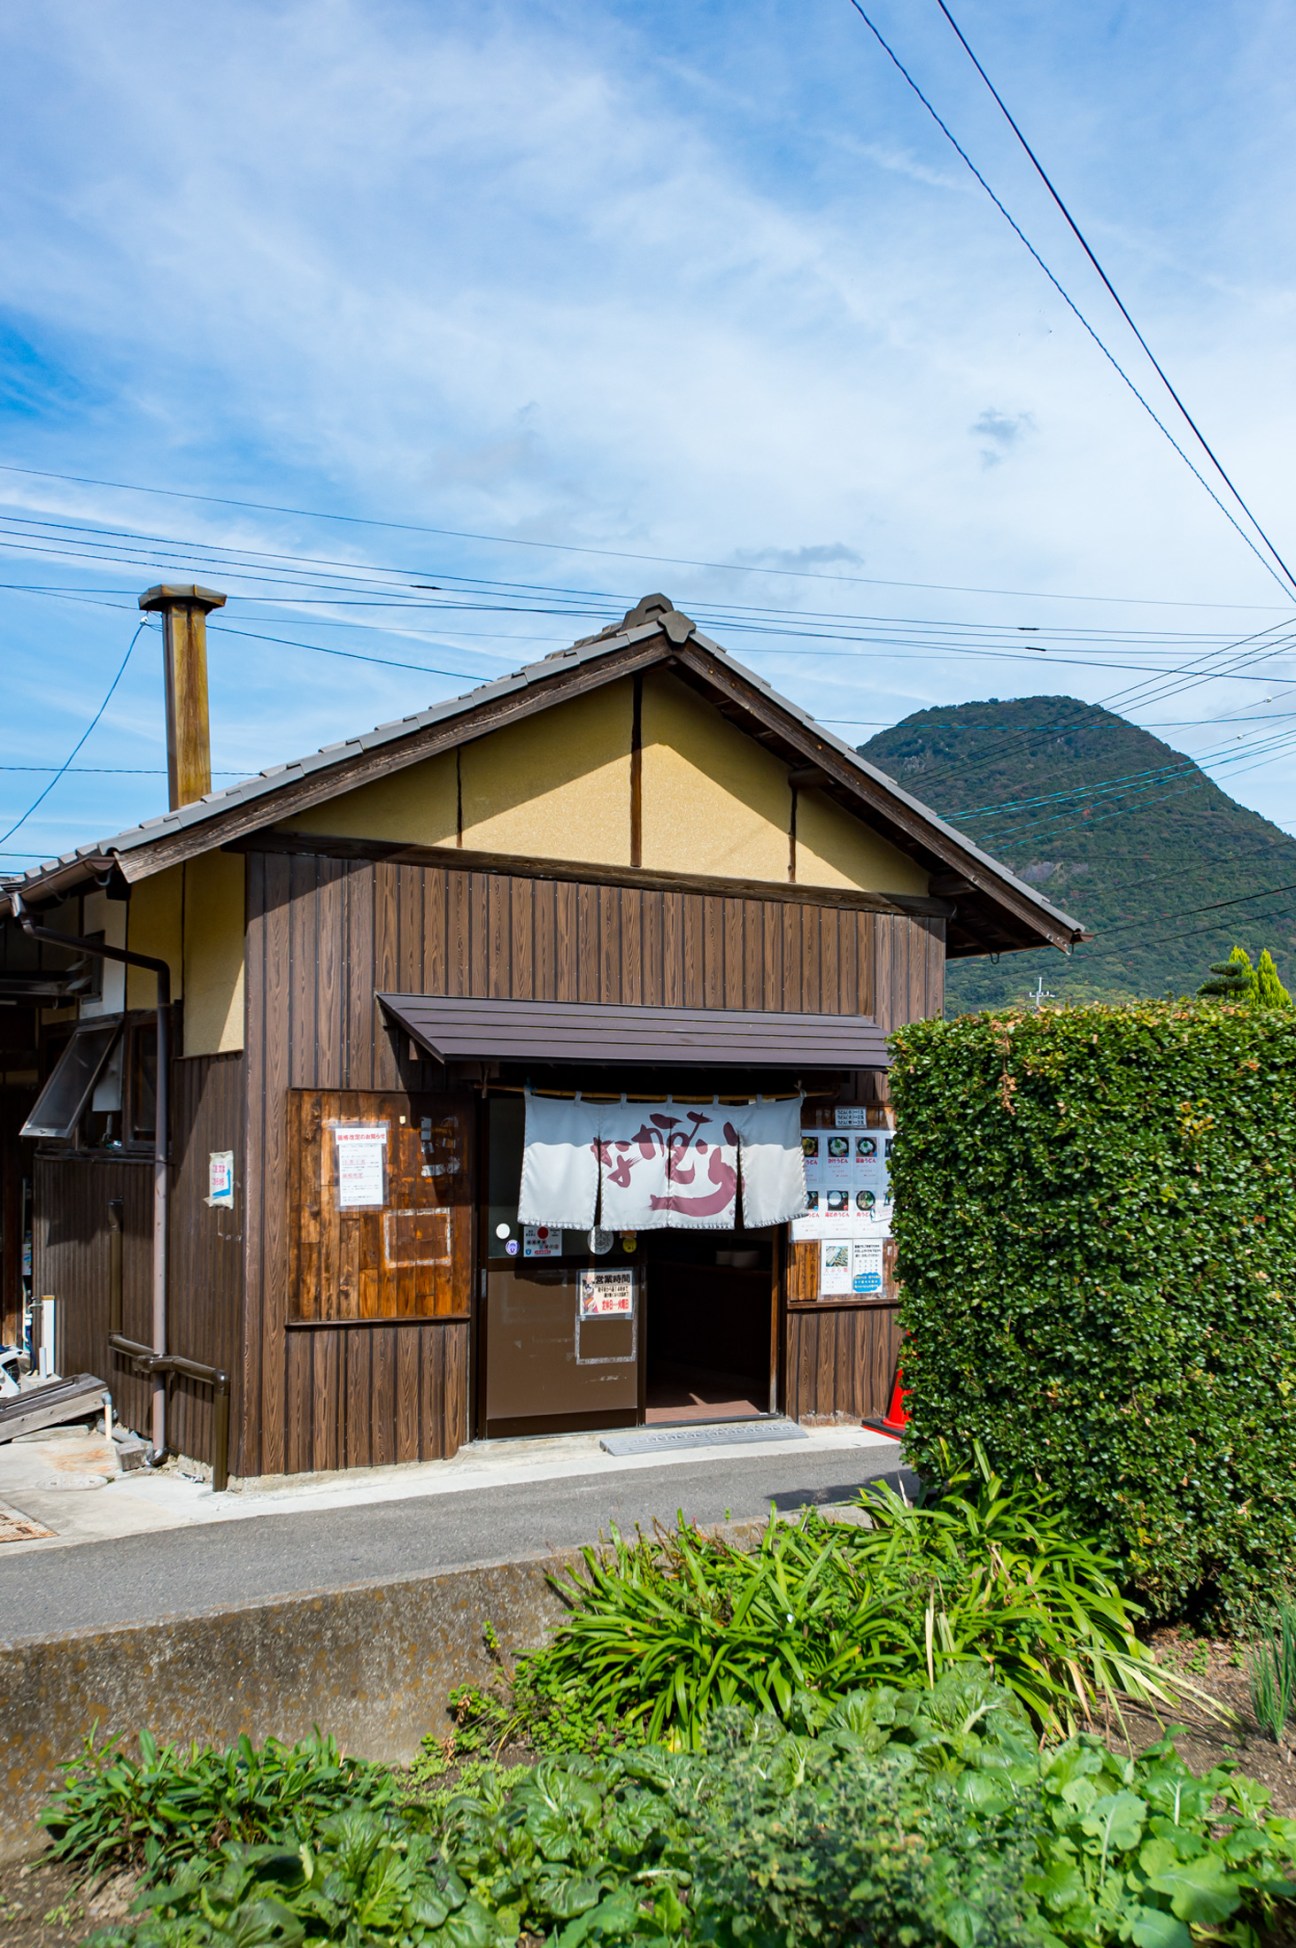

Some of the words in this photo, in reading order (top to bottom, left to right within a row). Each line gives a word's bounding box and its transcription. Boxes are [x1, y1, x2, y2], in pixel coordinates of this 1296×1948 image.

[590, 1111, 746, 1217] なかむら
[595, 1274, 630, 1285] 営業時間
